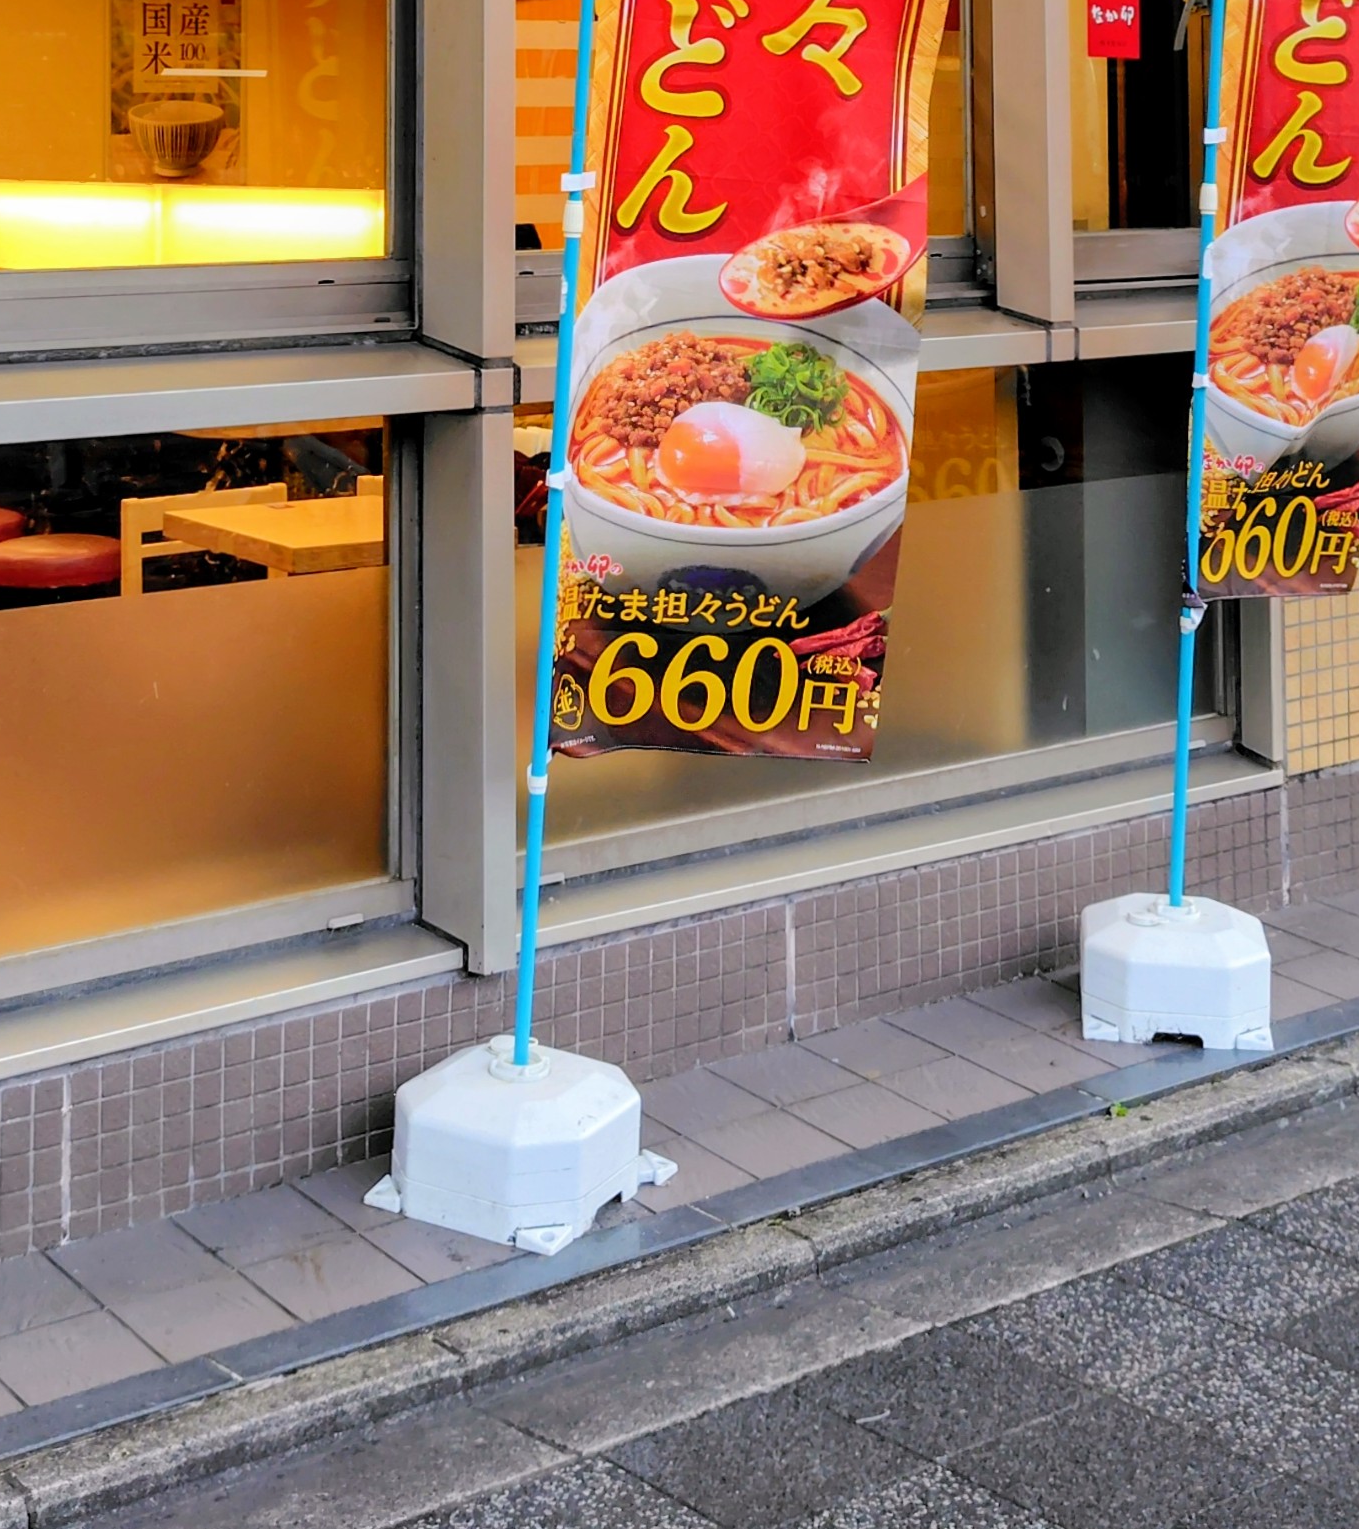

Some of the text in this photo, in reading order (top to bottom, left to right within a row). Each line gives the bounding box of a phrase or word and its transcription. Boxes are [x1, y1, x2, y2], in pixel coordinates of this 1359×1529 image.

[1091, 4, 1135, 26] なか卯
[807, 656, 863, 675] (税込)
[588, 632, 860, 735] 660円
